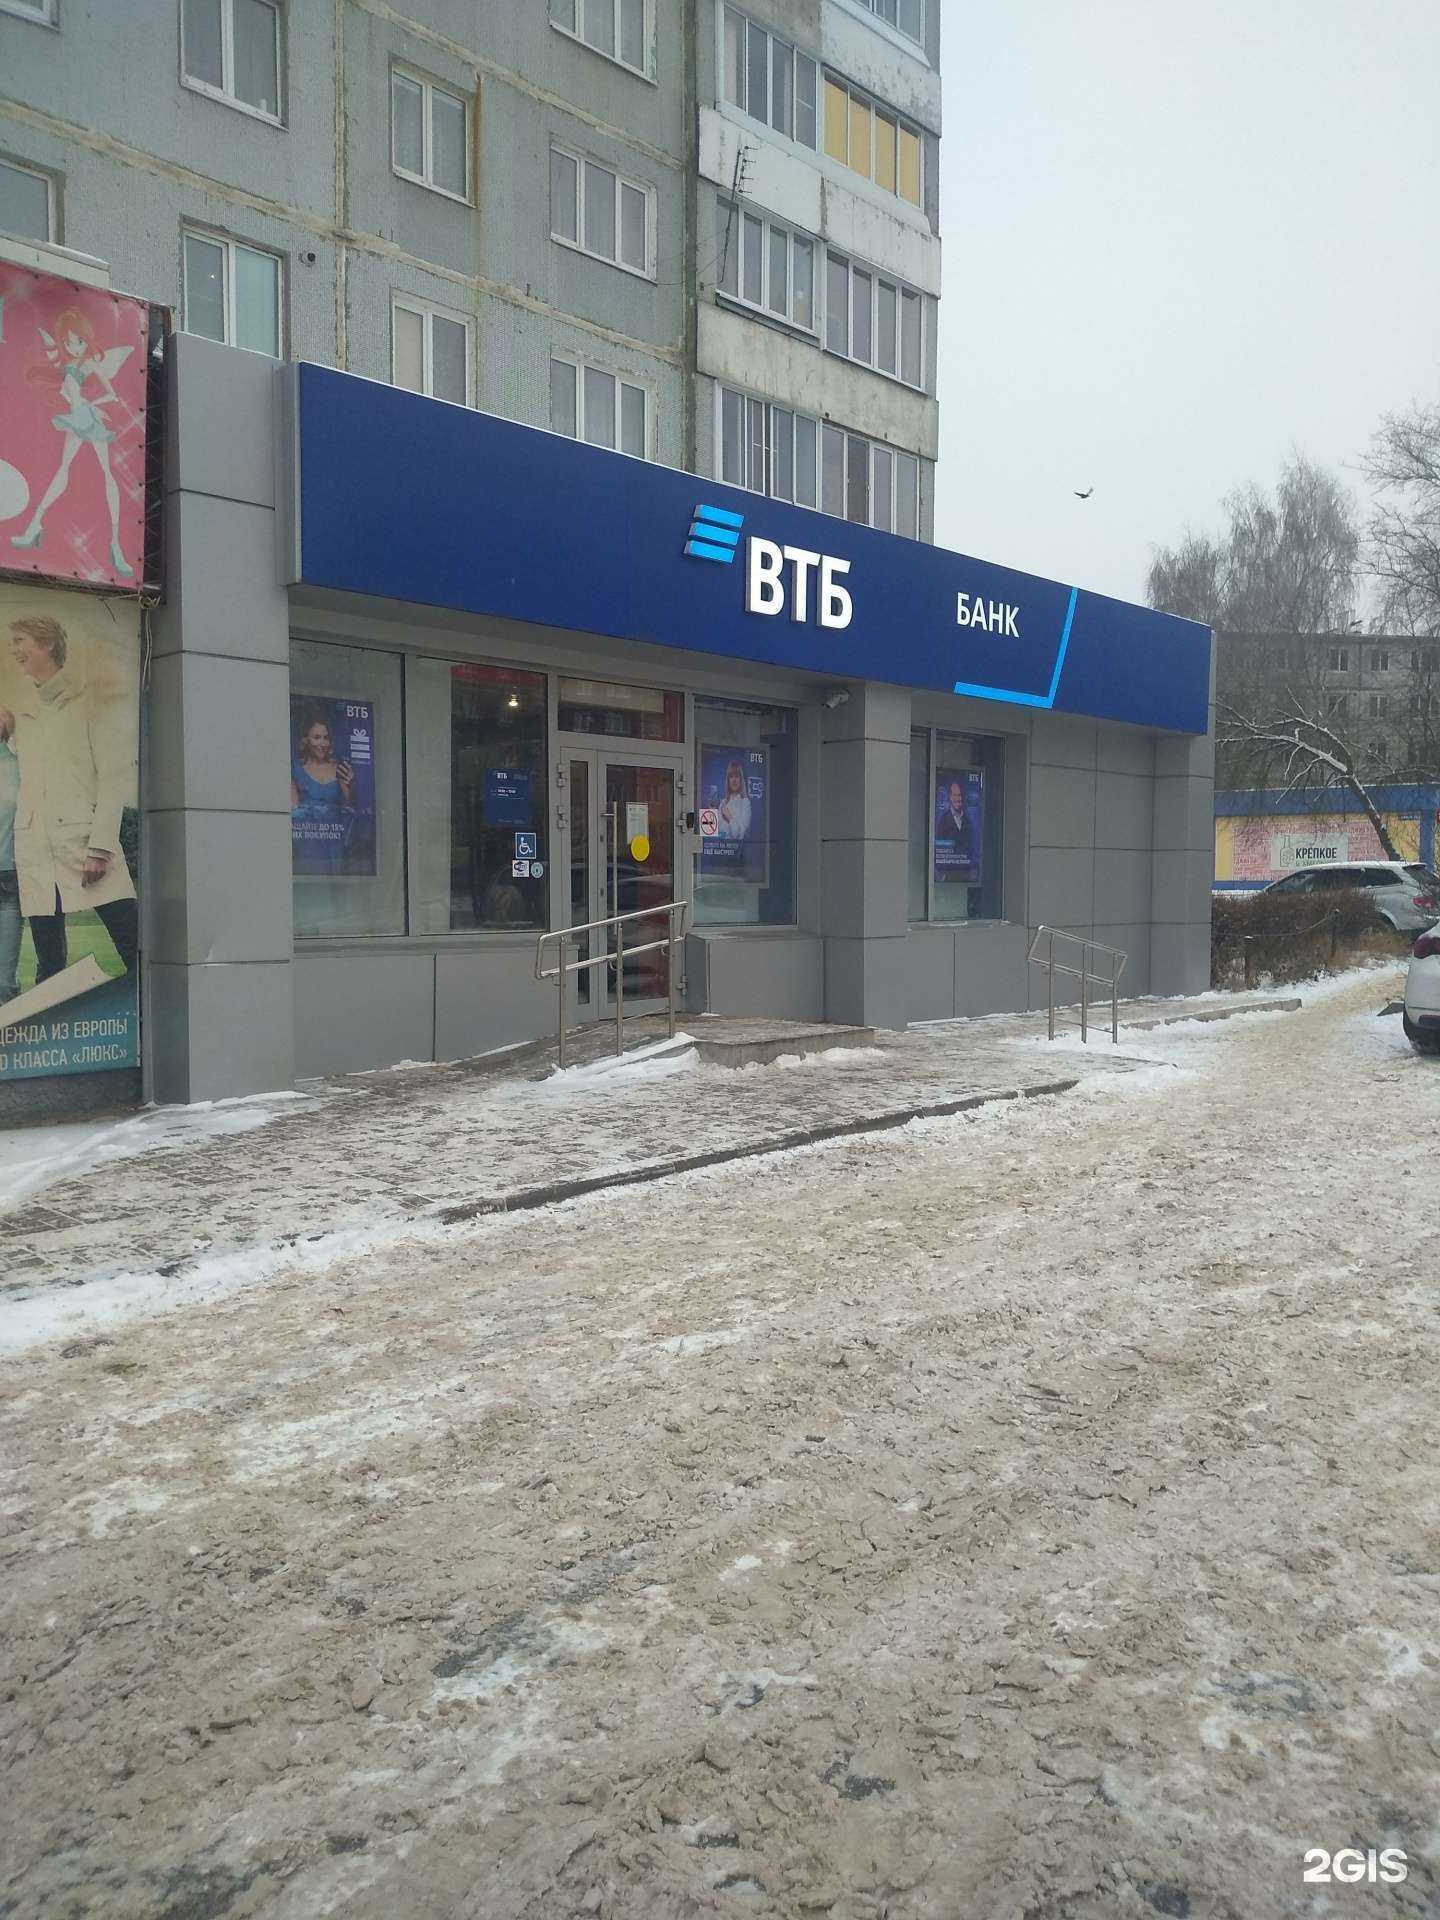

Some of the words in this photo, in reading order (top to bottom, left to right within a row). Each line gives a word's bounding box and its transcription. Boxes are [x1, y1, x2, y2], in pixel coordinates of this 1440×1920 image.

[745, 536, 854, 630] ВТБ
[956, 592, 1020, 638] БАНК
[347, 705, 369, 719] ВТБ
[1296, 848, 1337, 859] КРЕПКОЕ
[51, 1023, 69, 1041] ИЗ
[74, 1018, 128, 1038] ЕВРОПЫ
[13, 1049, 68, 1070] КЛАССА
[72, 1044, 128, 1064] «ЛЮКС»
